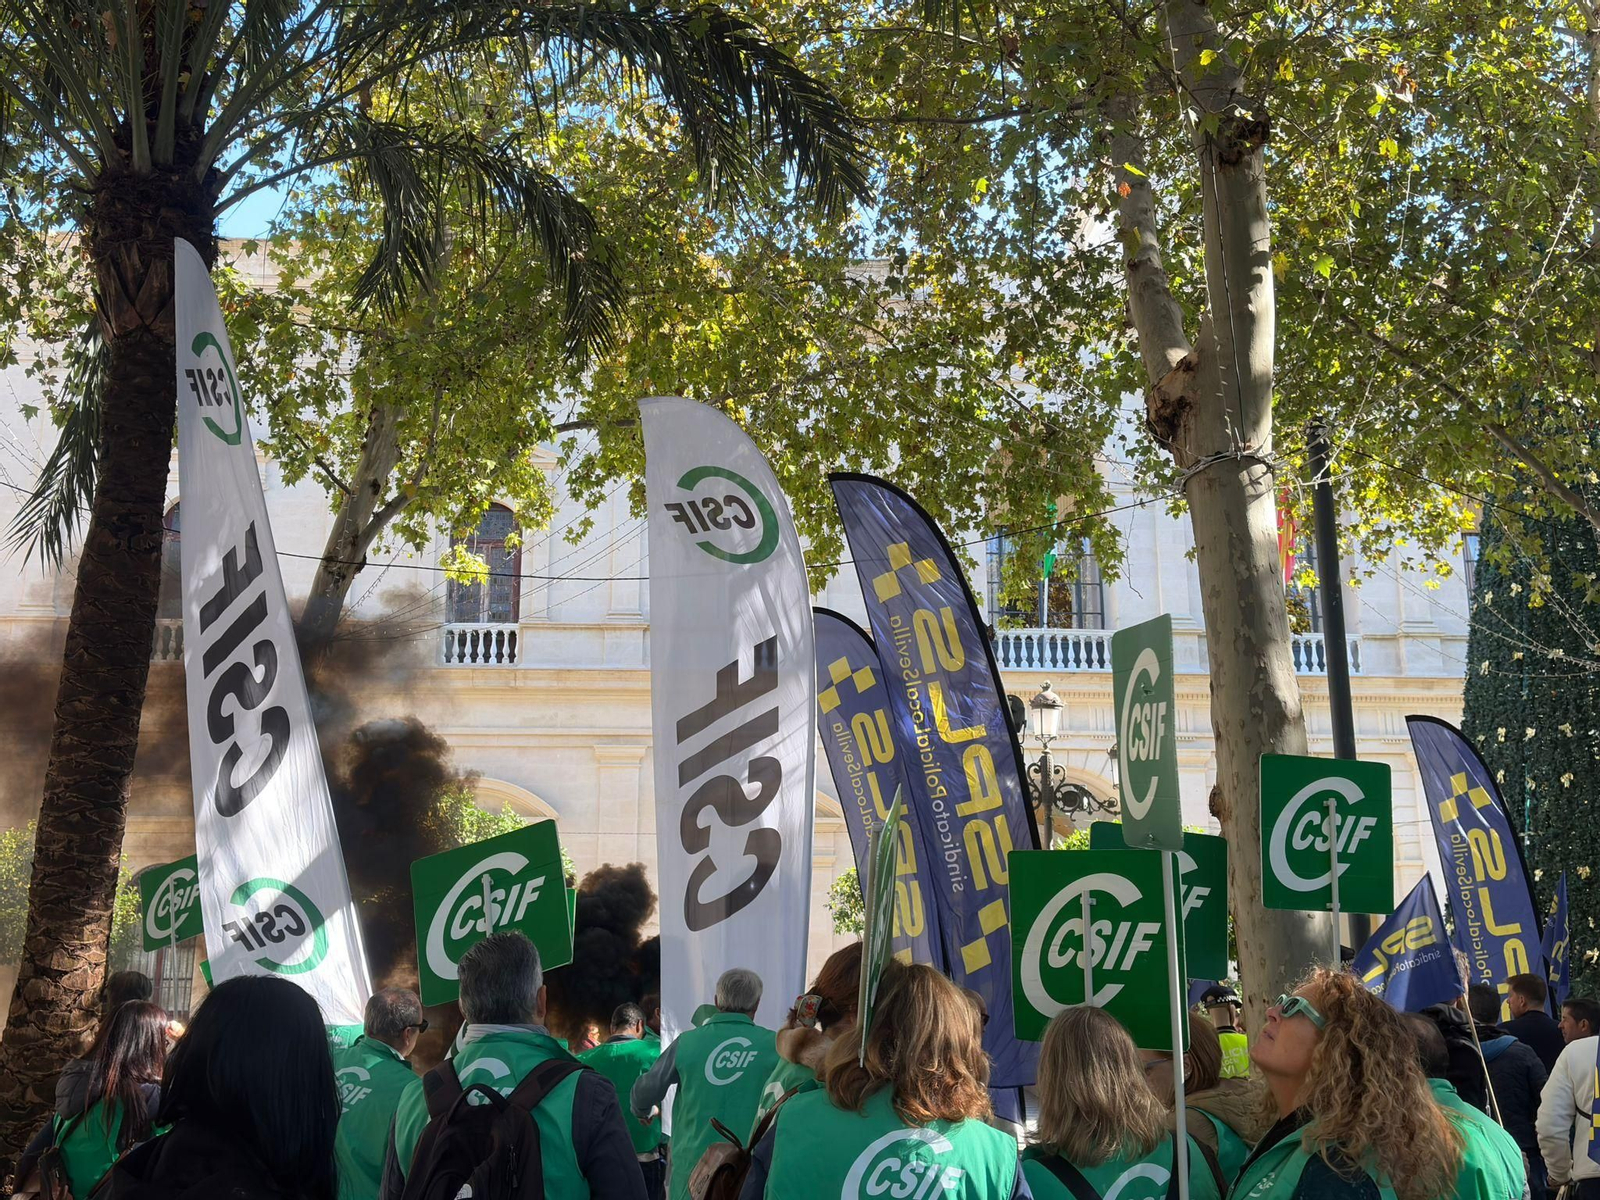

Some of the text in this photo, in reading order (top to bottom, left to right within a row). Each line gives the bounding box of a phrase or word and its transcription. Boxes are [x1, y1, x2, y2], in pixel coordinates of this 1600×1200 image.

[1129, 701, 1167, 762] CSIF
[1292, 811, 1378, 853] CSIF
[450, 876, 546, 941] CSIF
[1048, 918, 1161, 971] CSIF
[715, 1051, 758, 1068] CSIF
[340, 1083, 372, 1105] SIF
[866, 1157, 965, 1200] CSIF
